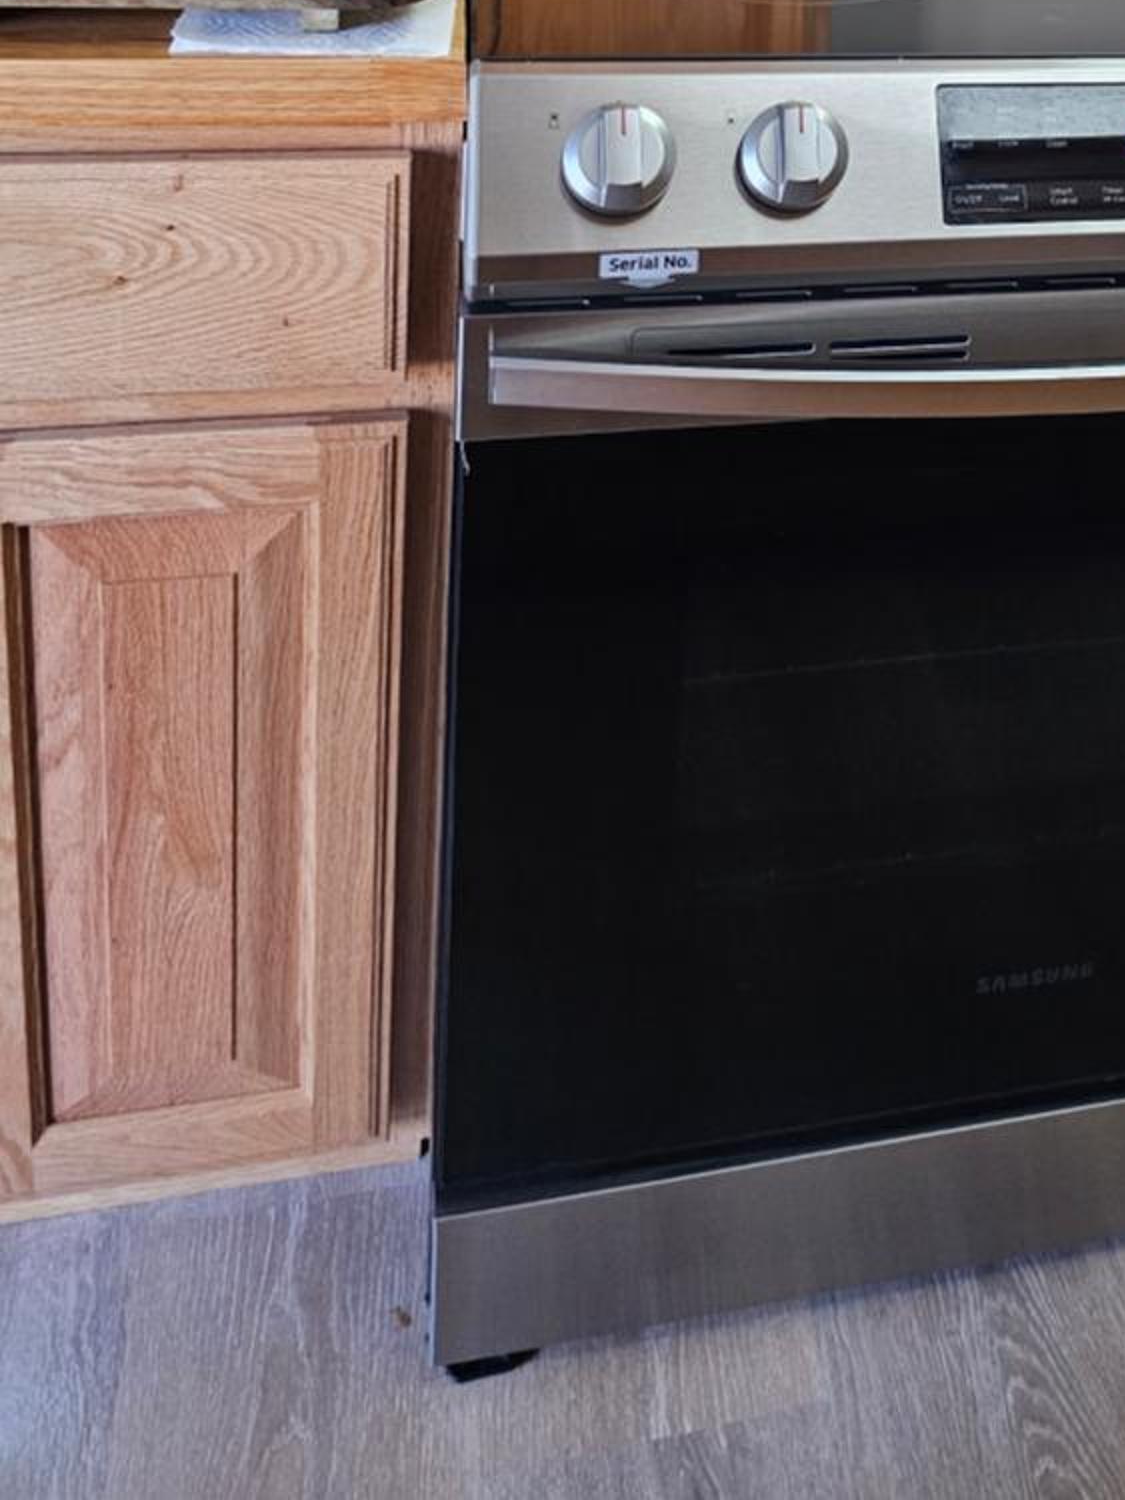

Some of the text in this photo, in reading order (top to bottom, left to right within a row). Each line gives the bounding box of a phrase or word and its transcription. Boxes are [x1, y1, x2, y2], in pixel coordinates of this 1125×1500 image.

[608, 255, 692, 272] Serial No.
[975, 960, 1096, 994] SAMSUNG
